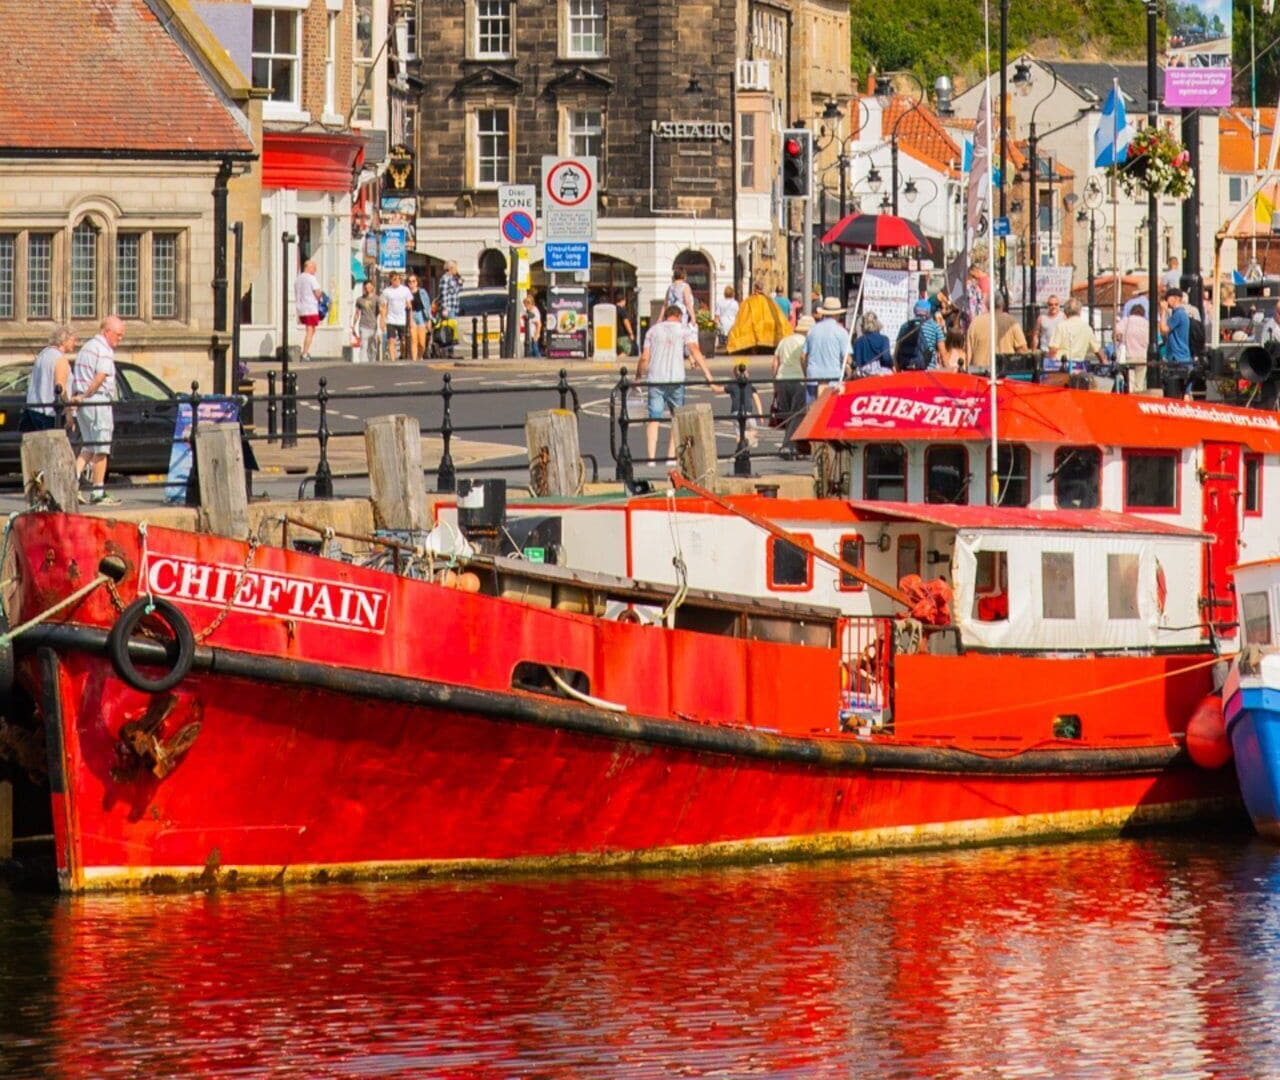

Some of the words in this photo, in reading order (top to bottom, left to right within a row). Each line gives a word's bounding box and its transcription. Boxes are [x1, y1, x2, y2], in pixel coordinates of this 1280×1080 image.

[502, 198, 532, 208] ZONE
[547, 245, 586, 253] Unsuitable
[565, 252, 582, 261] long
[552, 260, 581, 268] vehicles
[850, 396, 982, 428] CHIEFTAIN
[149, 559, 383, 627] CHIEFTAIN
